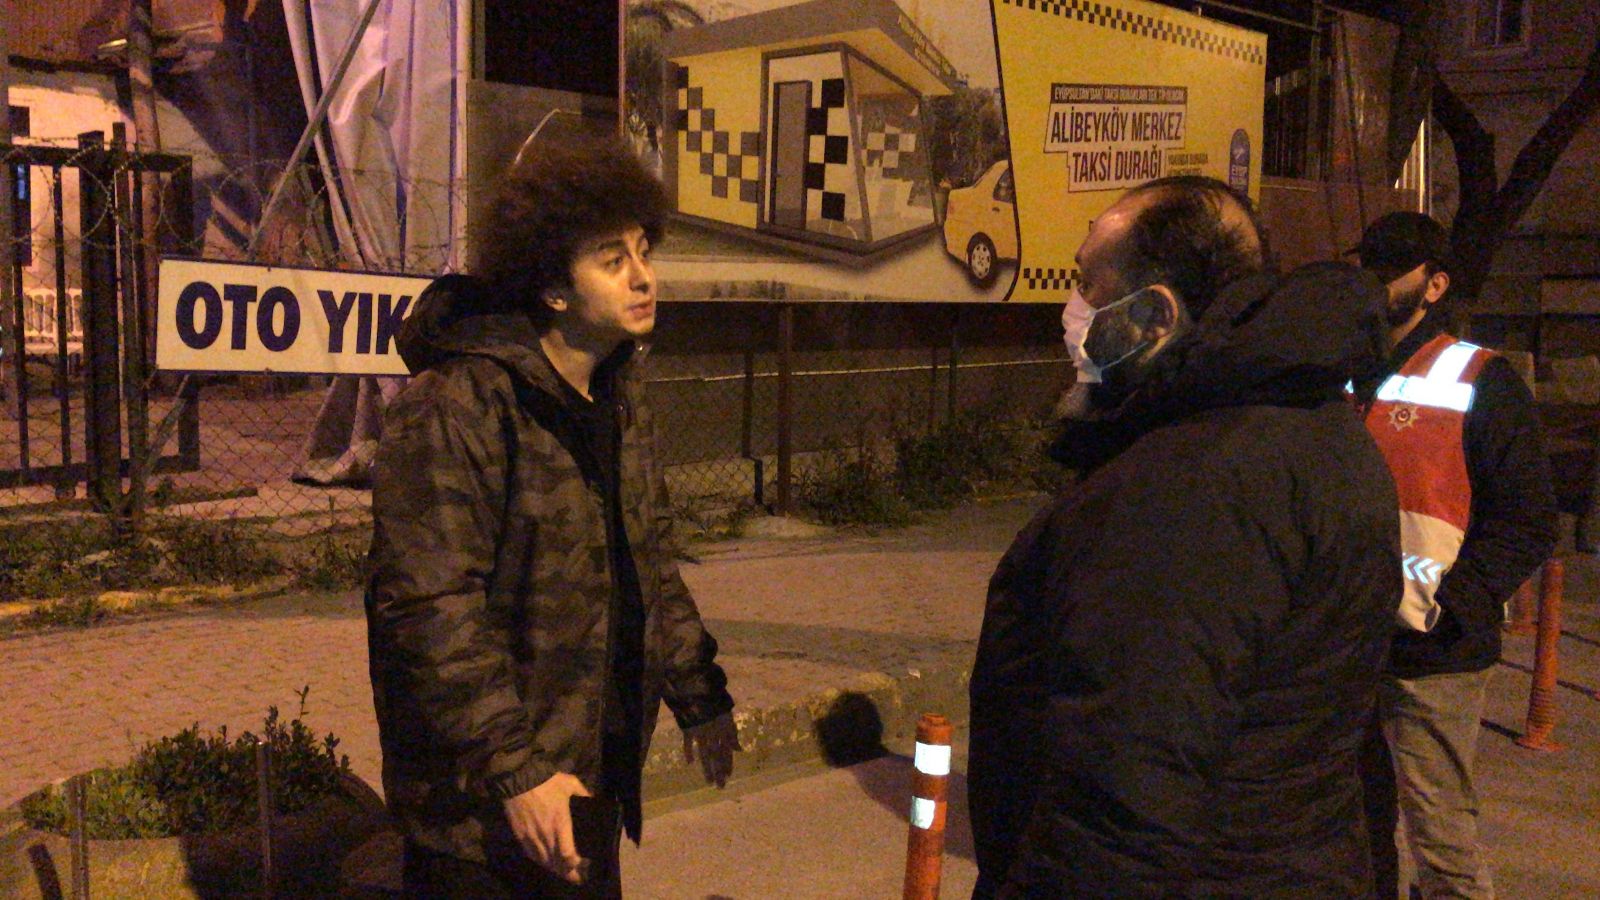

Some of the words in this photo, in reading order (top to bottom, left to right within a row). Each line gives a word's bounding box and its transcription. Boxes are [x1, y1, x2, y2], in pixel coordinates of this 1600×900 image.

[1051, 107, 1128, 143] ALİBEYKÖY
[1131, 112, 1182, 141] MERKEZ
[1073, 146, 1111, 182] TAKSİ
[1115, 144, 1161, 180] DURAĞI
[175, 281, 300, 351] OTO
